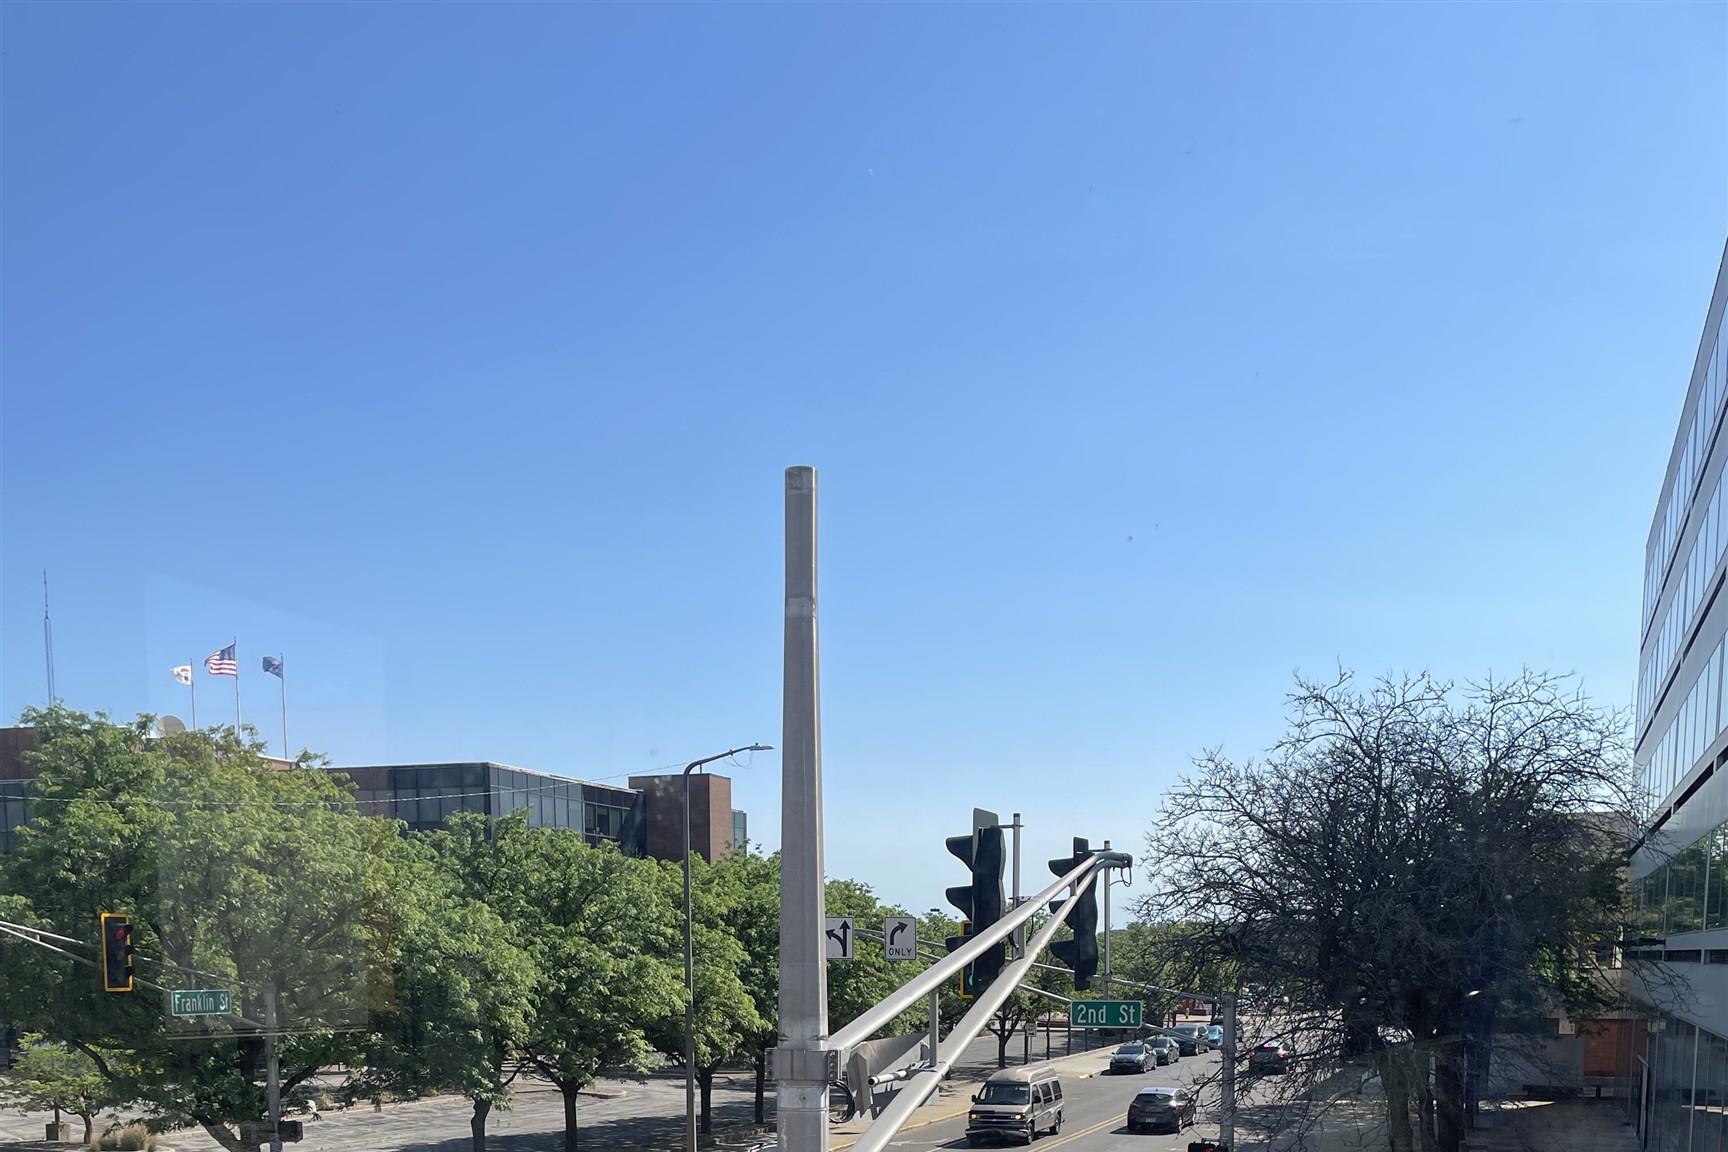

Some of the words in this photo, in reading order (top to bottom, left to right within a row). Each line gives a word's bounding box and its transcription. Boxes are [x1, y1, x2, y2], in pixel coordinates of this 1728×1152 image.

[888, 947, 912, 956] ONLY
[174, 993, 214, 1012] Franklin
[219, 992, 229, 1010] St
[1077, 1004, 1106, 1023] 2nd
[1119, 1004, 1136, 1024] St
